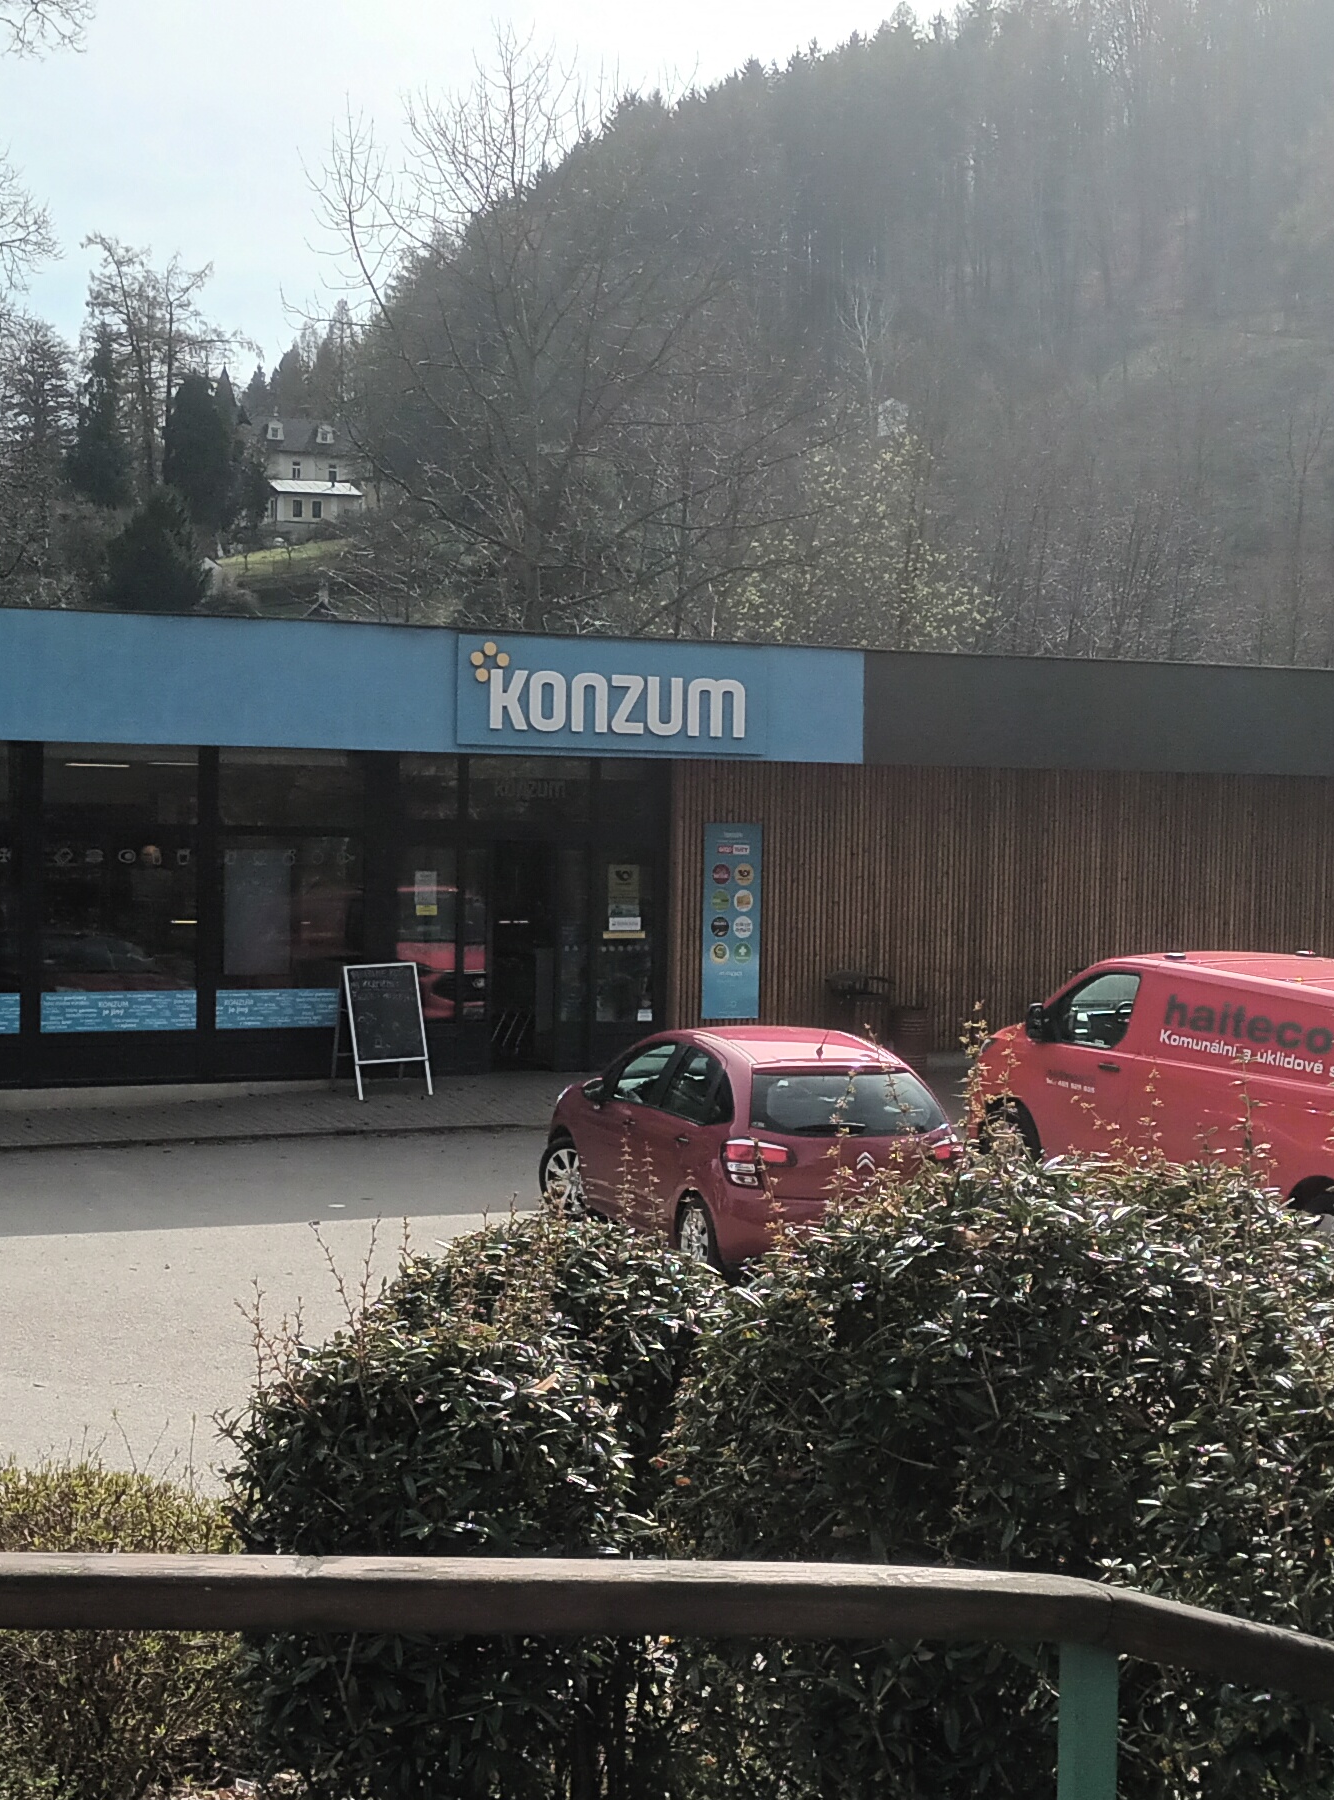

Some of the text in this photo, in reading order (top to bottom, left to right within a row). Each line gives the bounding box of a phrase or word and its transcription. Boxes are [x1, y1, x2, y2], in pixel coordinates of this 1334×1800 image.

[489, 669, 746, 738] KONZUM
[1159, 1028, 1236, 1057] Komunální
[1257, 1049, 1323, 1074] úklidové
